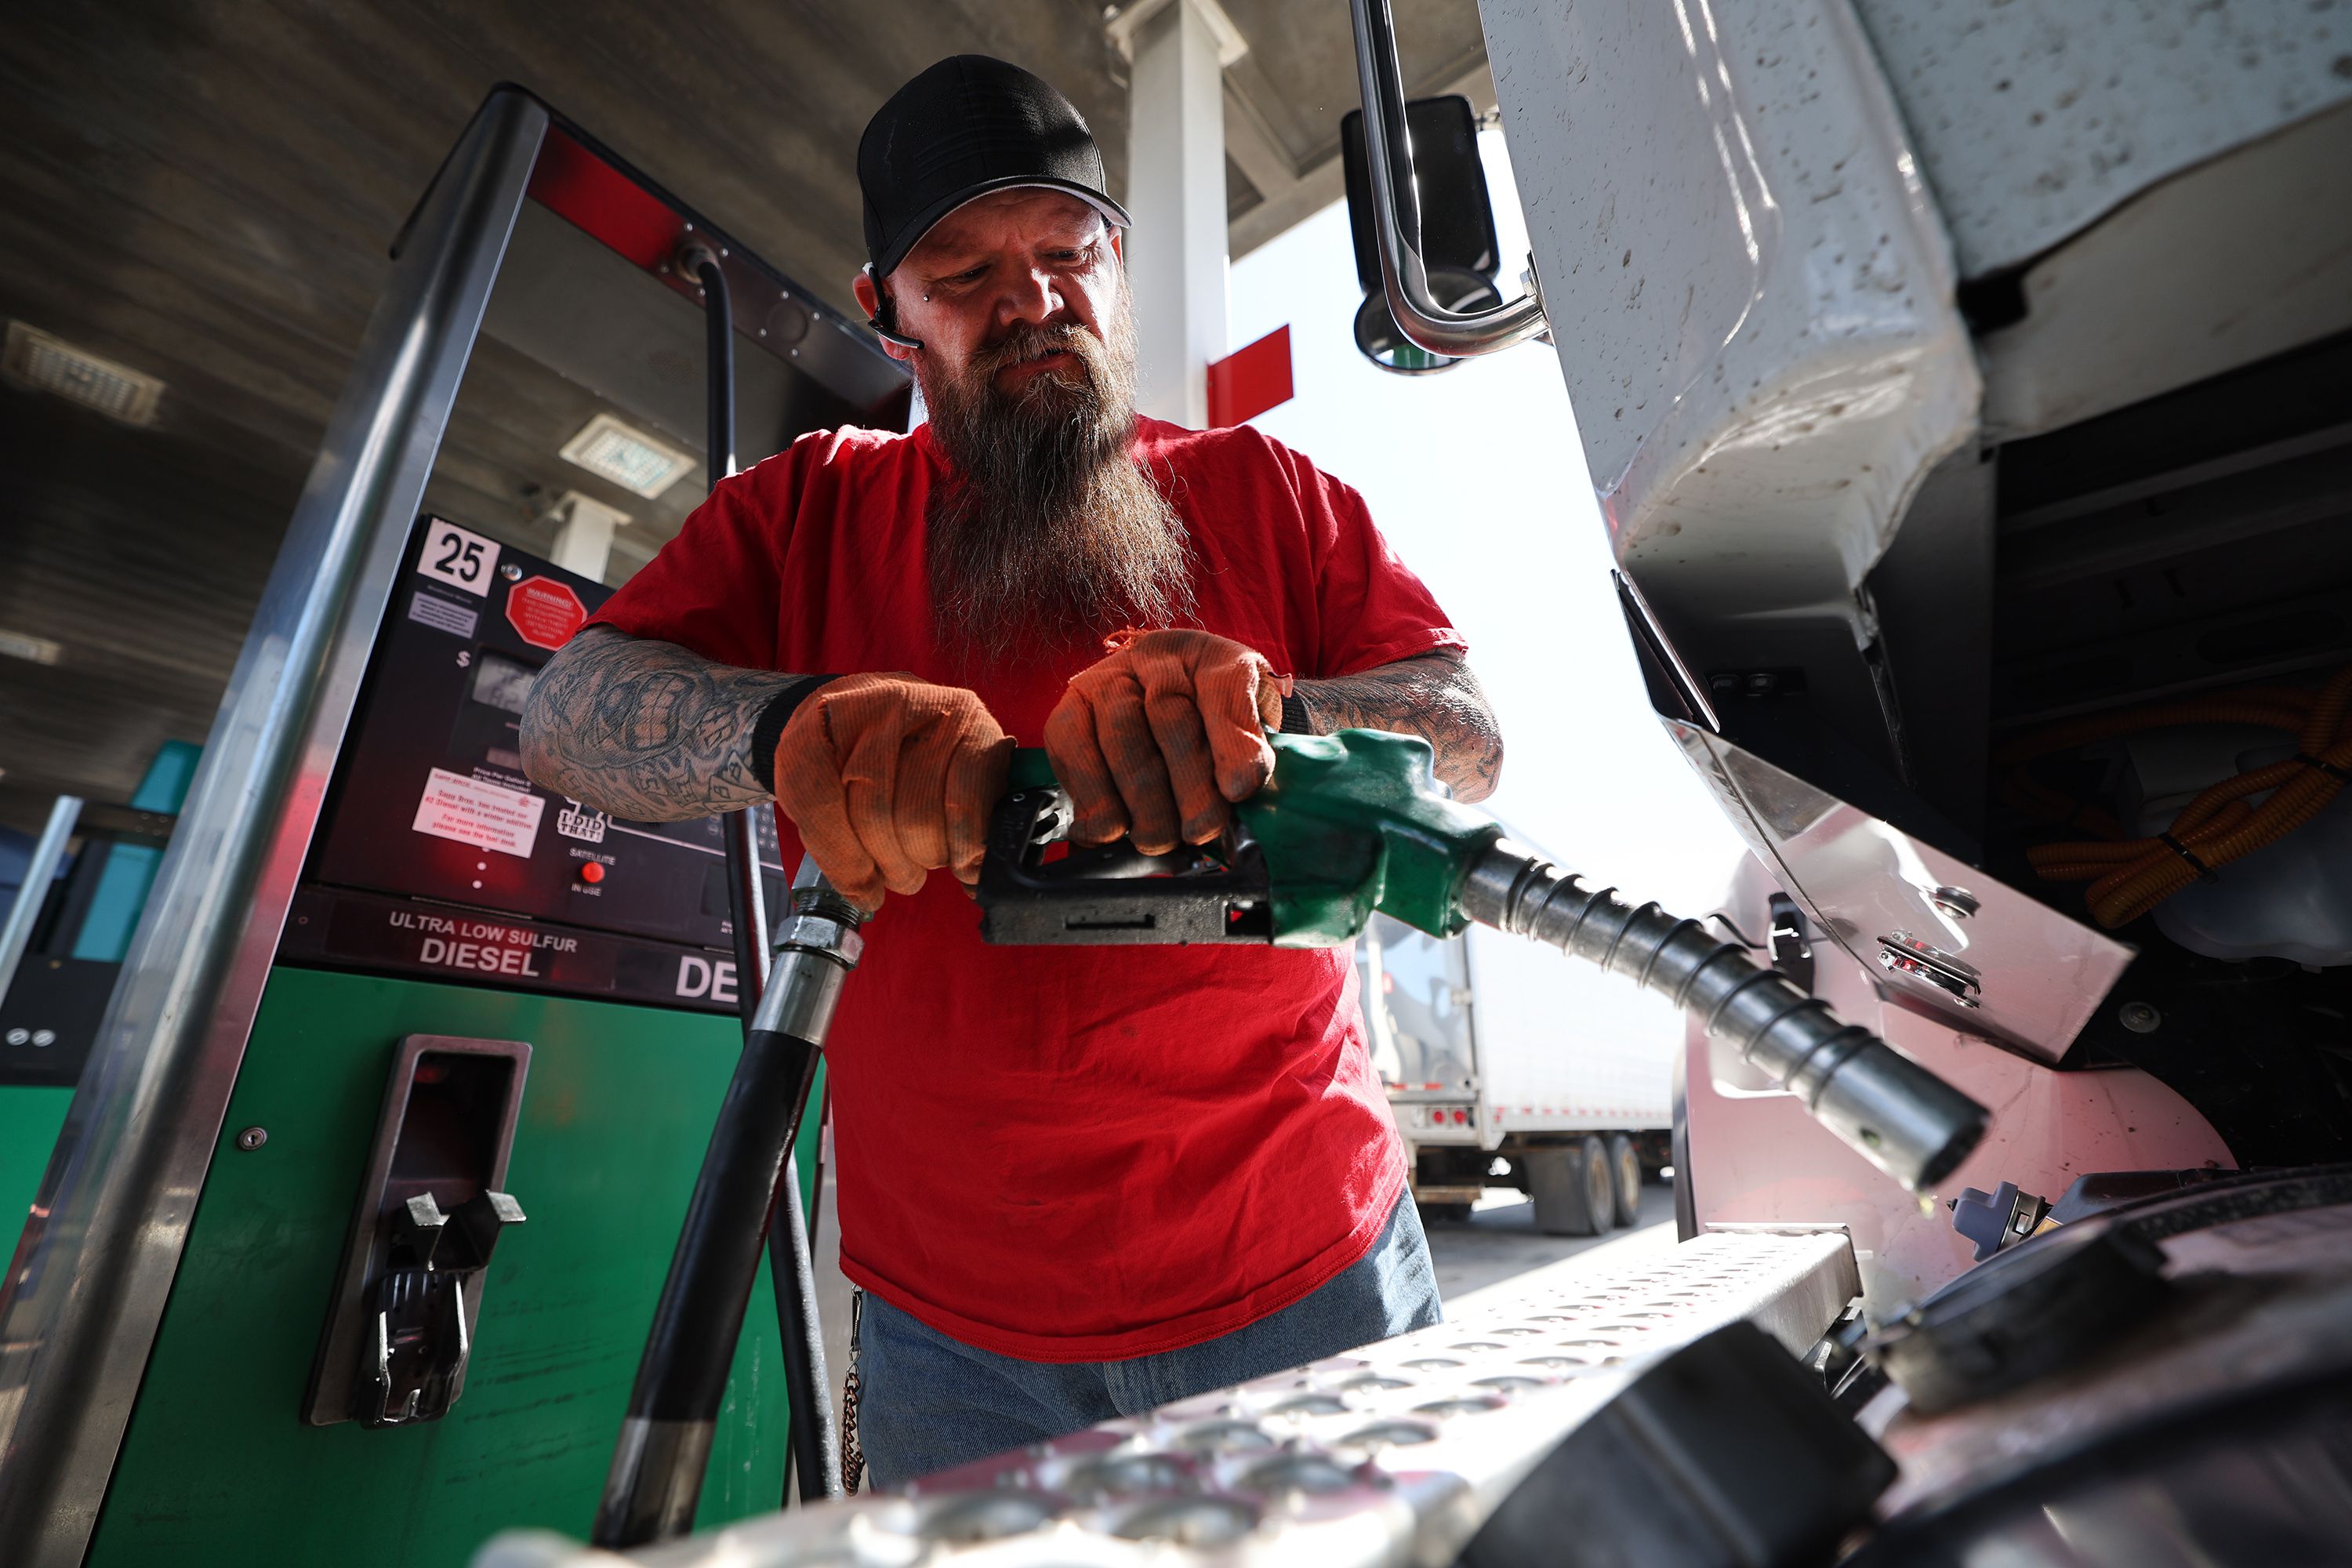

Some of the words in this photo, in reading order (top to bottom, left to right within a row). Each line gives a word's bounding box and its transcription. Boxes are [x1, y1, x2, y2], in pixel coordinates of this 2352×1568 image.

[435, 533, 484, 582] 25
[456, 651, 471, 668] $
[561, 812, 568, 823] I
[574, 816, 602, 830] DID
[569, 847, 616, 866] SATELLITE
[571, 883, 582, 892] IN
[582, 886, 602, 897] USE
[389, 911, 456, 935] ULTRA
[460, 923, 506, 942] LOW
[508, 930, 578, 953] SULFUR
[419, 938, 539, 978] DIESEL
[675, 956, 739, 1004] DE
